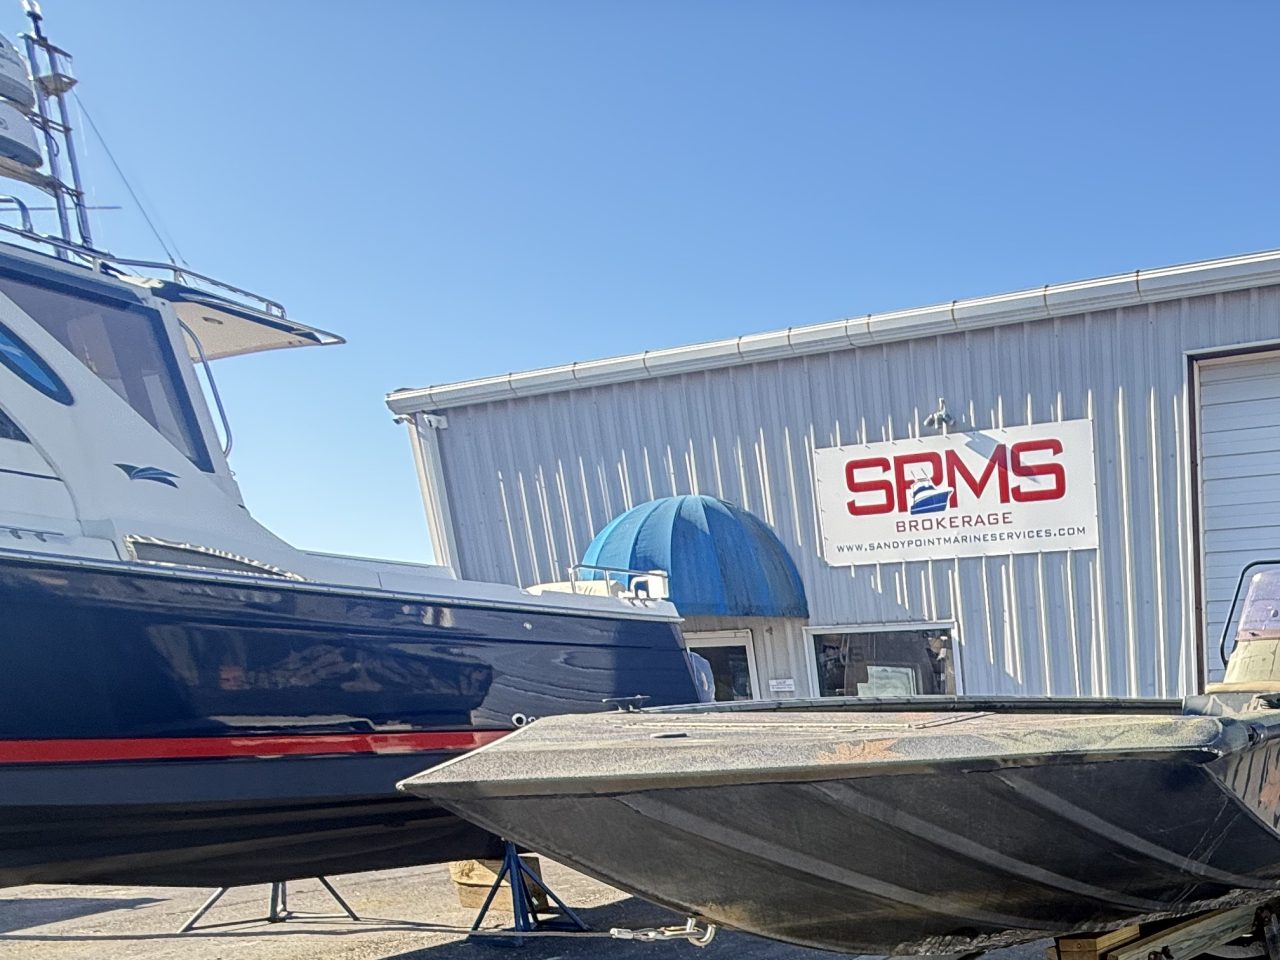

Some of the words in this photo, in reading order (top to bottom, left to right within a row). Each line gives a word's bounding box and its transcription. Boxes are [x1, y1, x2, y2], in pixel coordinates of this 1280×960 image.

[845, 439, 1065, 516] SPMS
[896, 512, 1013, 533] BROKERAGE
[836, 526, 1086, 553] WWW.SANDYPOINTMARINESERVICES.COM
